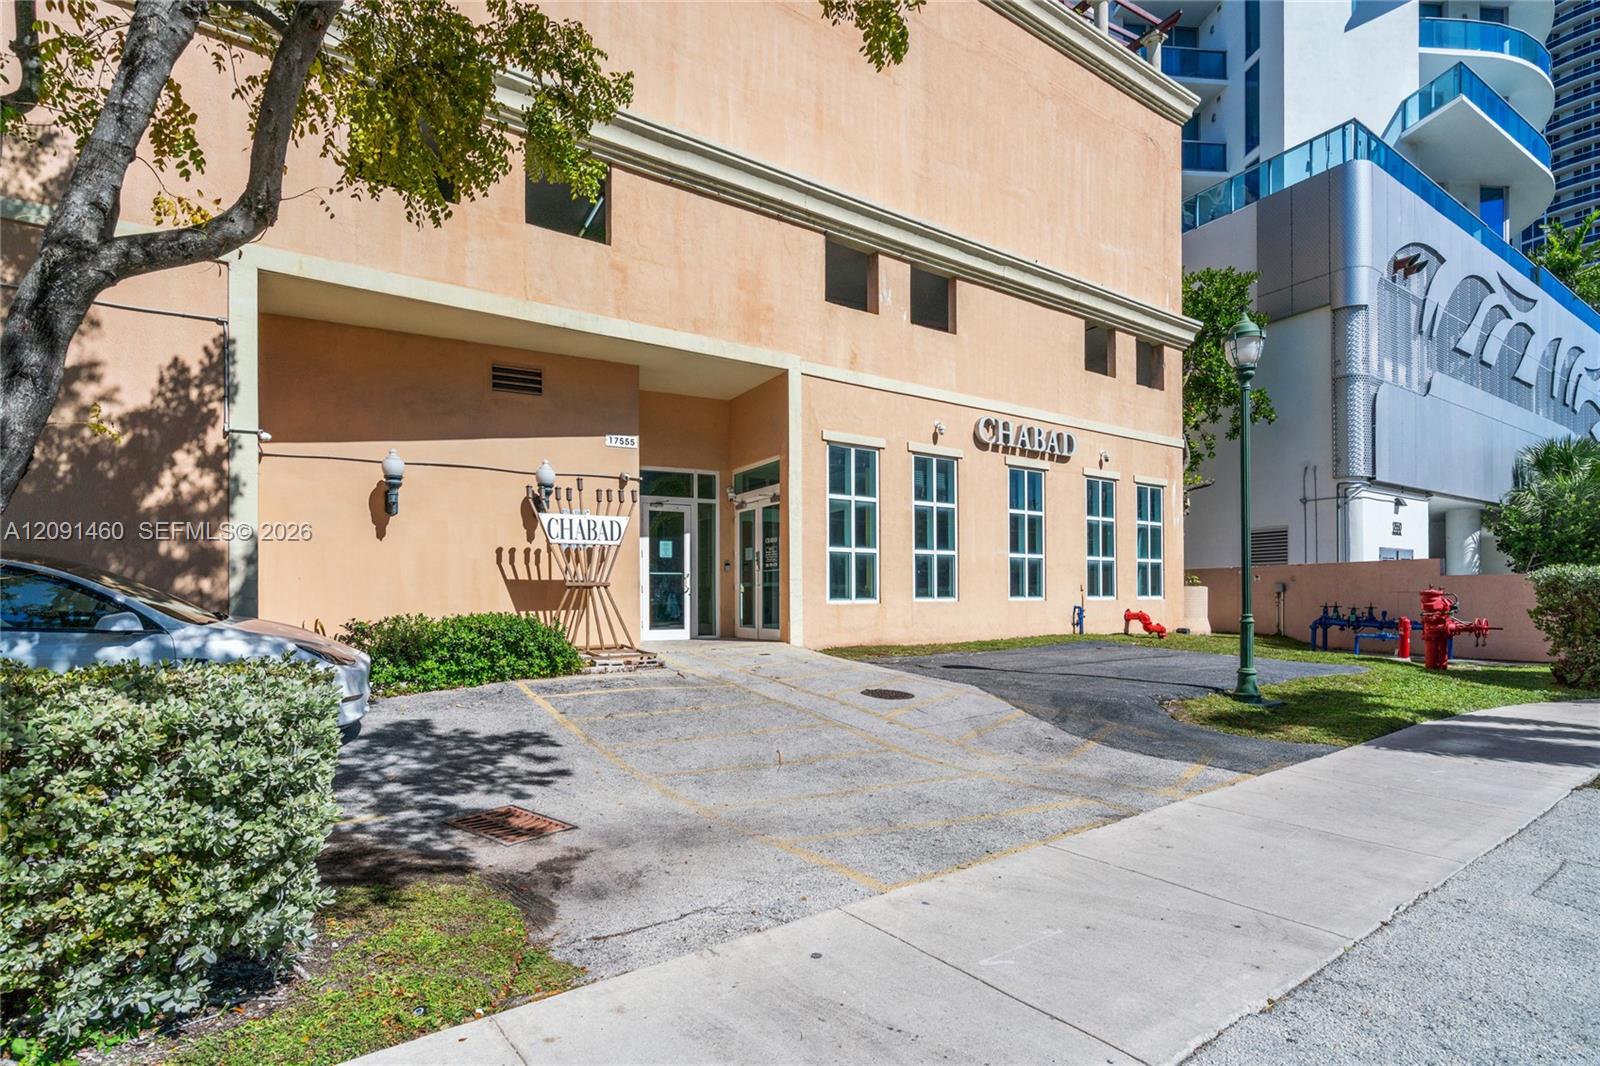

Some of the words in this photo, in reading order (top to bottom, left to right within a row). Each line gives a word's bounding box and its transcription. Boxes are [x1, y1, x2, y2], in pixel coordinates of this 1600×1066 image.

[609, 436, 635, 446] 17555
[974, 416, 1077, 457] CHABAD
[547, 517, 622, 542] CHABAD
